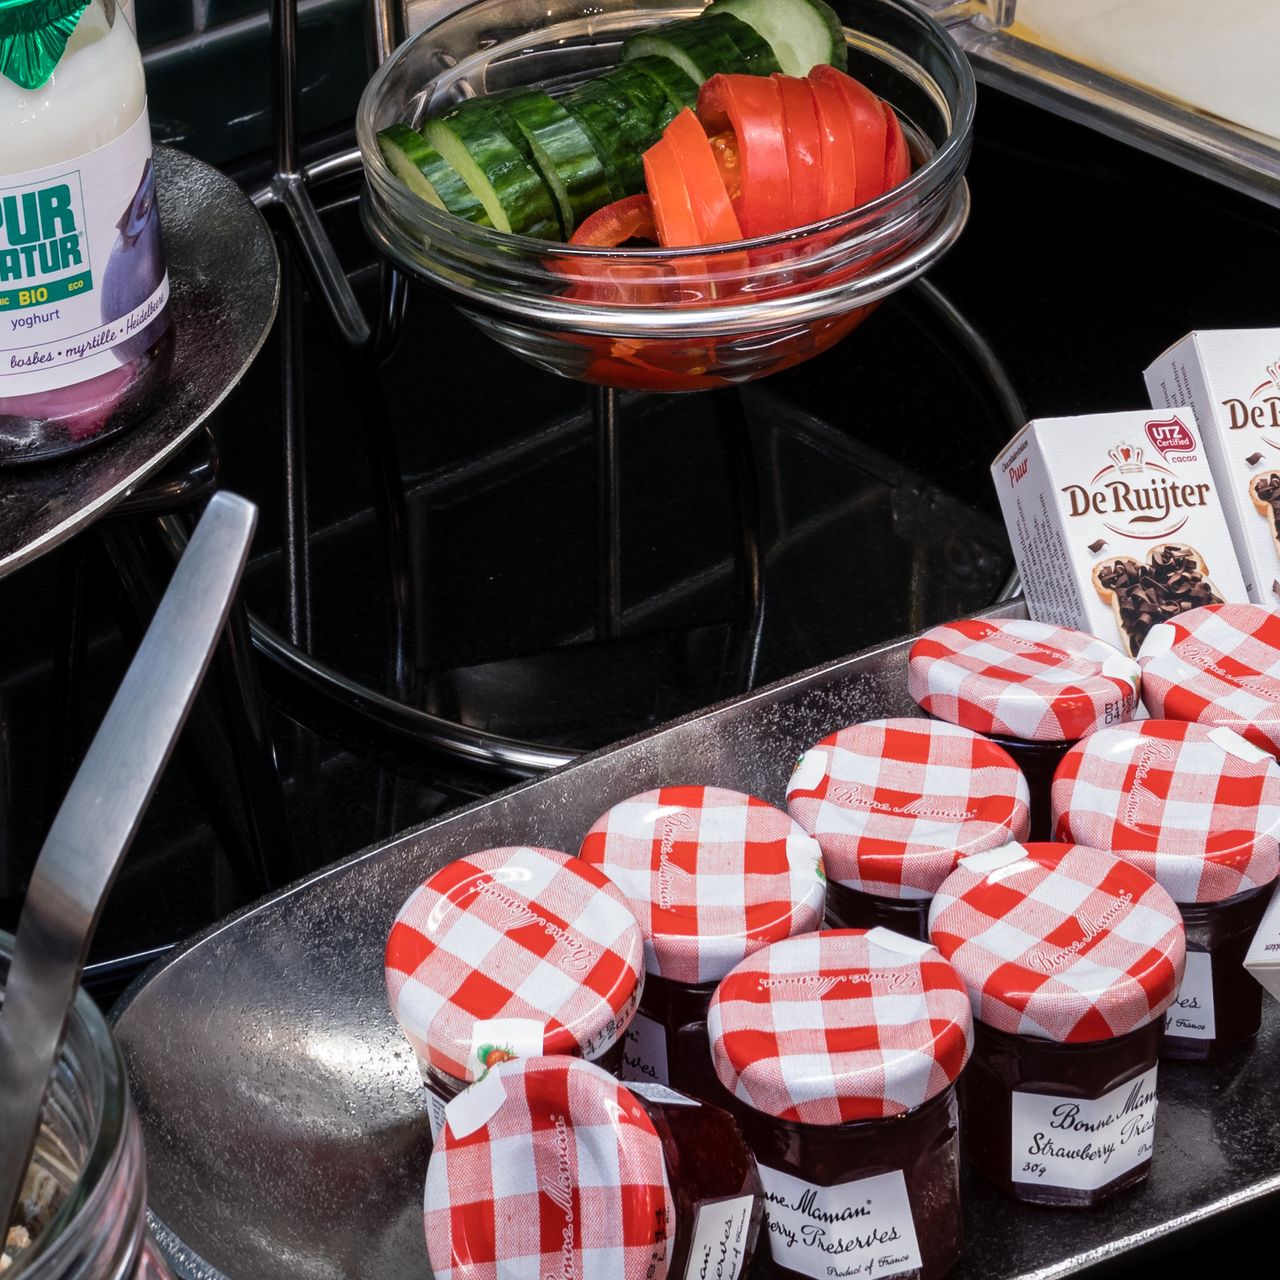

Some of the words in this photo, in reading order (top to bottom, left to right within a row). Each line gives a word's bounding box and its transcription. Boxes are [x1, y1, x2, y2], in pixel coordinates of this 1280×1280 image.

[18, 287, 48, 306] BIO
[68, 280, 84, 291] ECO
[10, 308, 60, 331] yoghurt
[10, 351, 54, 369] bosbes
[65, 328, 117, 358] myrtille
[126, 293, 165, 334] Heidelbeere
[1222, 398, 1264, 430] De
[1152, 426, 1183, 441] UTZ
[1156, 437, 1190, 448] Certified
[1008, 457, 1029, 489] Puur
[1171, 454, 1197, 463] cacao
[1061, 484, 1107, 517] De
[1104, 478, 1210, 524] Ruijter
[1135, 737, 1176, 780] Bonne
[828, 784, 892, 812] Bonne
[893, 797, 977, 820] Maman
[1123, 775, 1162, 830] Maman
[470, 879, 546, 930] Maman
[545, 921, 597, 971] Bonne
[1028, 941, 1084, 972] Bonne
[1078, 889, 1133, 944] Maman
[756, 974, 848, 998] Maman
[849, 970, 919, 991] Bonne
[1175, 1018, 1206, 1030] France
[1050, 1103, 1115, 1132] Bonne
[1028, 1132, 1116, 1164] Strawberry
[540, 1114, 575, 1224] Maman
[790, 1188, 872, 1224] Maman
[801, 1224, 902, 1255] Preserves
[826, 1265, 862, 1278] Product
[864, 1259, 874, 1275] of
[877, 1253, 910, 1267] France
